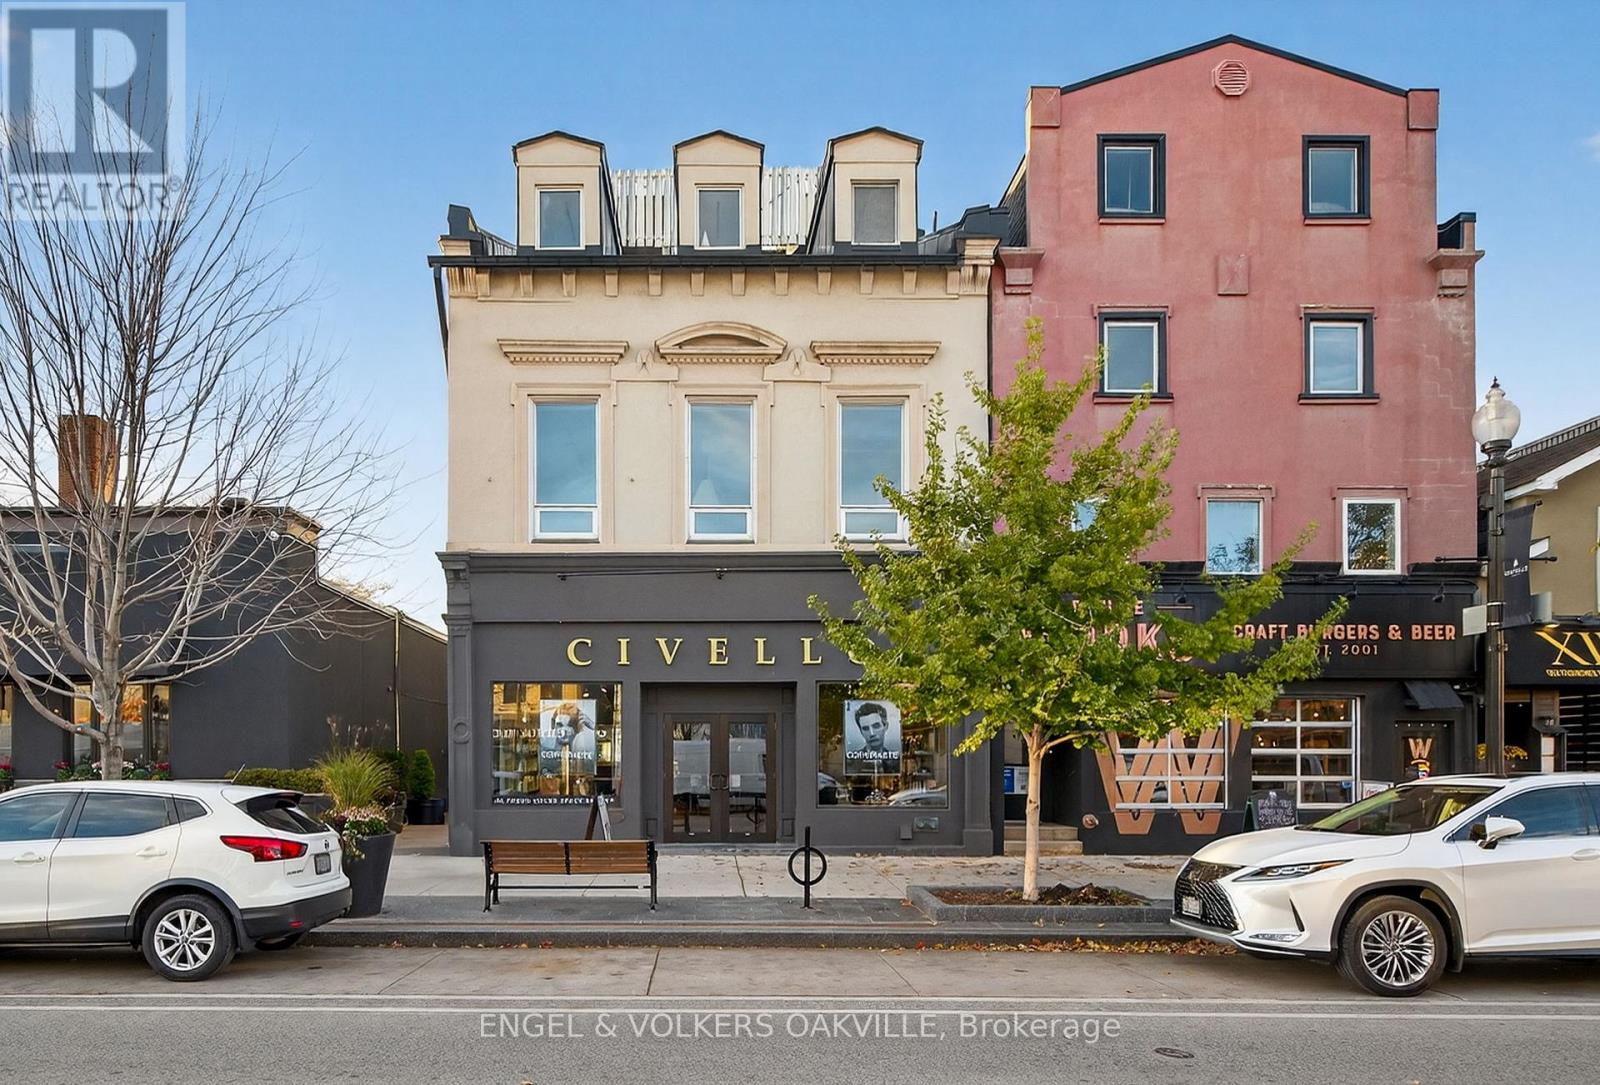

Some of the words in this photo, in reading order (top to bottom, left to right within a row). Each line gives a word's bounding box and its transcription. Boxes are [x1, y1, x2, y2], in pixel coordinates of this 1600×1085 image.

[1232, 624, 1288, 640] CRAFT
[1387, 624, 1403, 640] &
[1411, 624, 1456, 640] BEER
[566, 636, 865, 667] CIVELL
[1341, 644, 1378, 655] 2001
